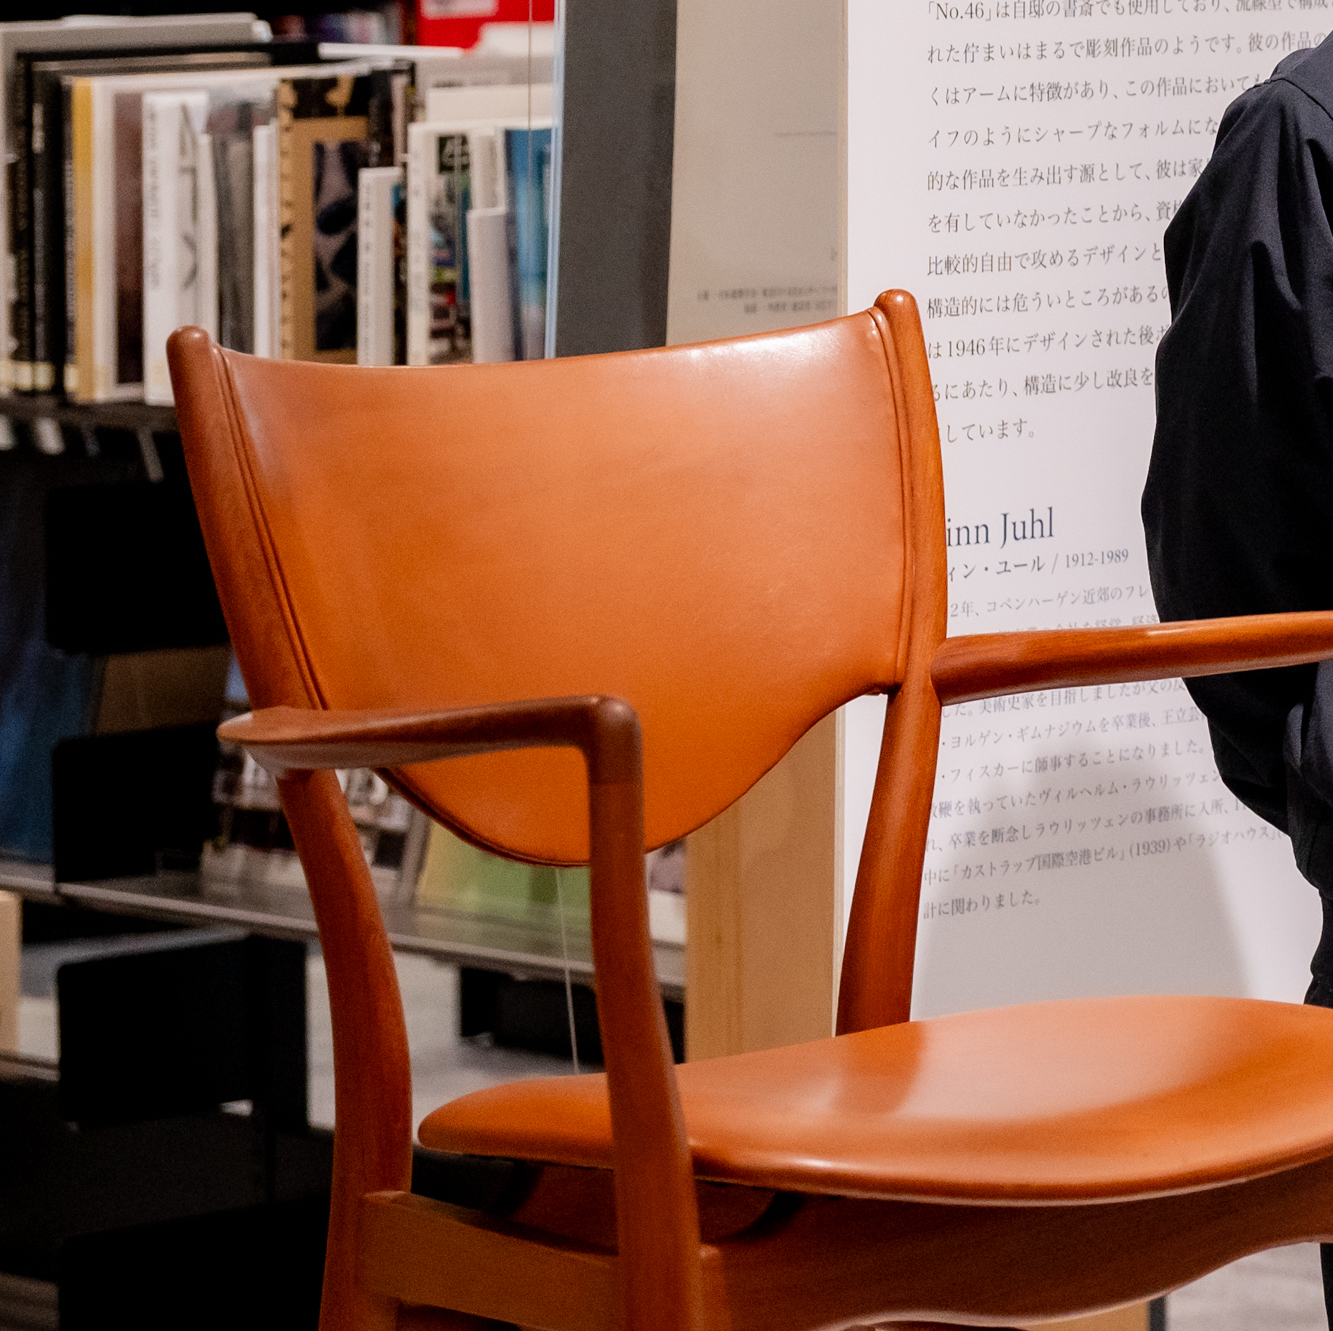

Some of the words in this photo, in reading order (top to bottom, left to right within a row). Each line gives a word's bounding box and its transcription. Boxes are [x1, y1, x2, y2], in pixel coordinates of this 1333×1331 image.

[927, 157, 1210, 191] 的な作品を生み出す源として、彼は家
[927, 242, 1162, 276] 比較的自由で攻めるデザインと
[1000, 506, 1055, 549] Juhl
[1065, 548, 1130, 569] 1912-1989
